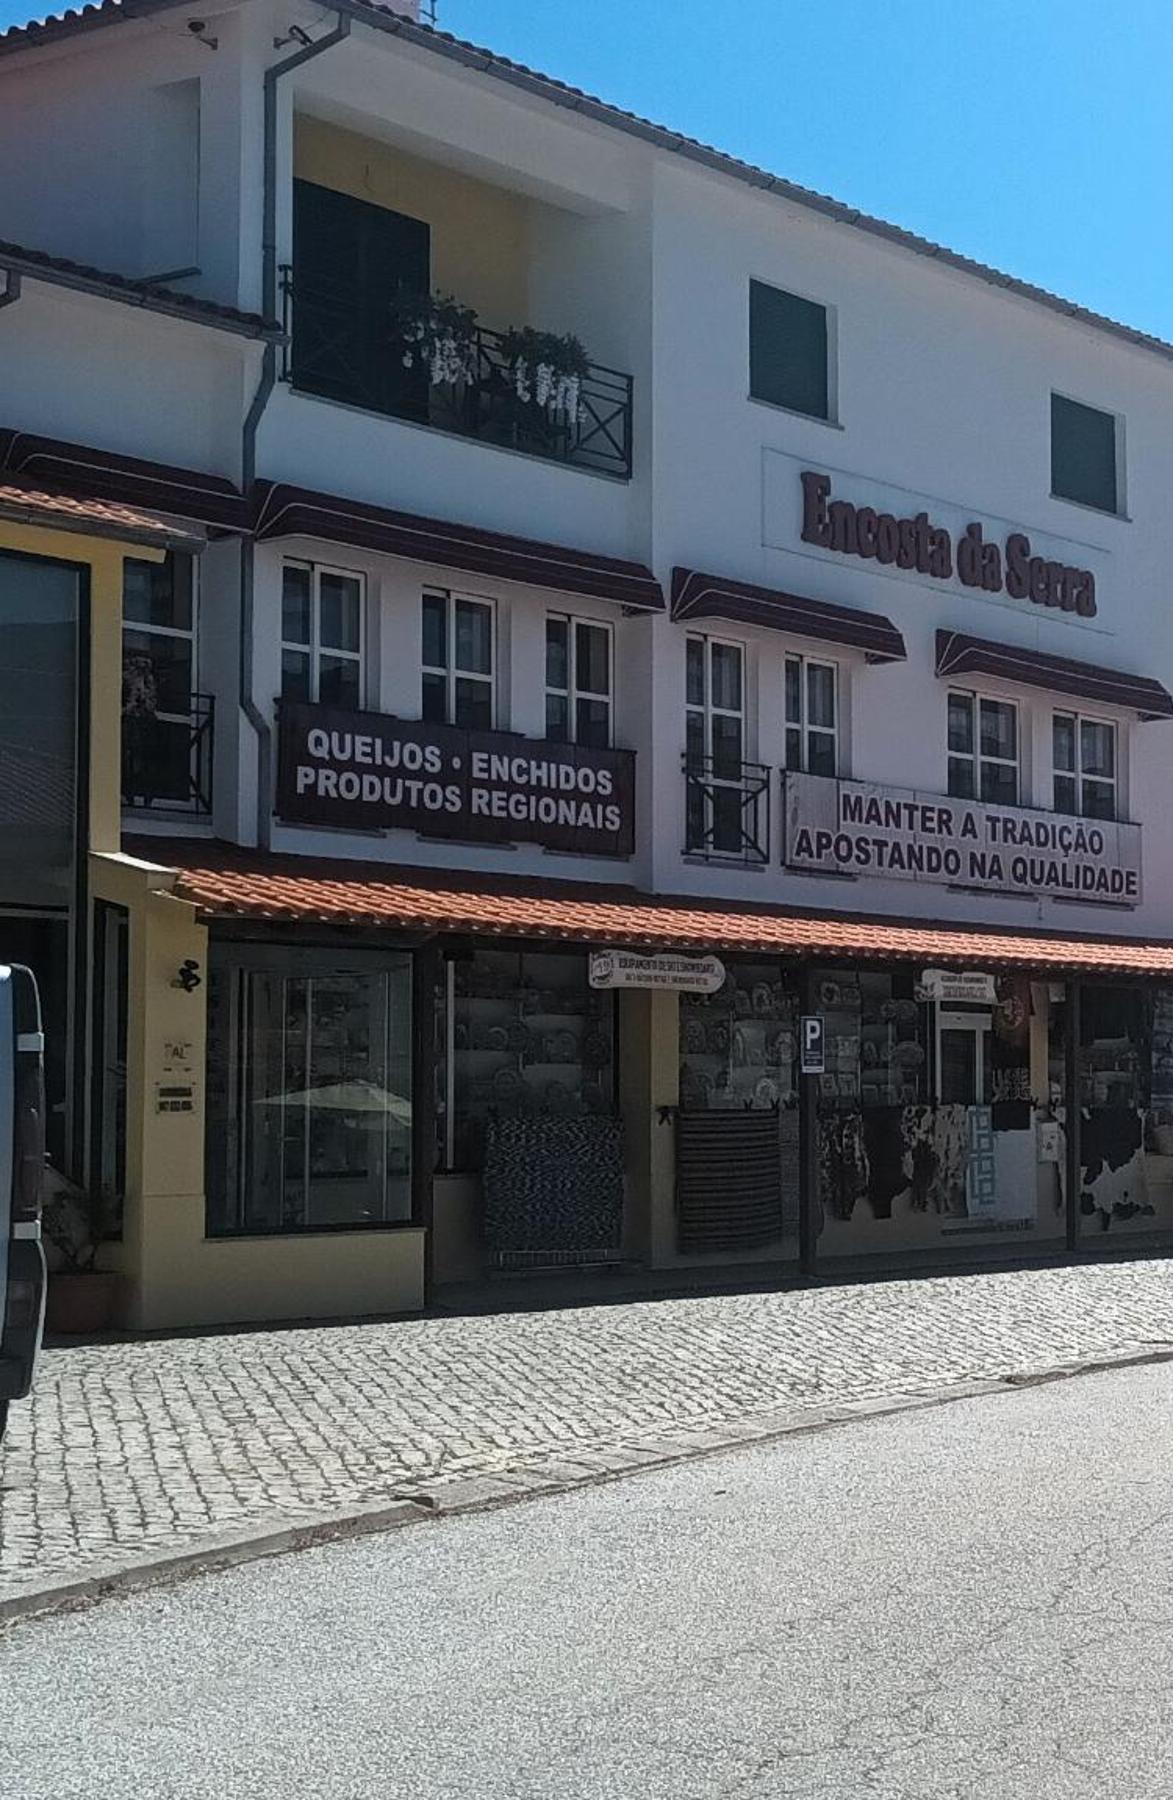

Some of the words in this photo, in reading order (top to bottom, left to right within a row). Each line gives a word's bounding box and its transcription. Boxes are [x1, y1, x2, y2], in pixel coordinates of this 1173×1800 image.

[800, 471, 952, 580] Encosta
[957, 522, 1002, 592] da
[1005, 533, 1098, 618] Serra
[307, 728, 442, 773] QUEIJOS
[471, 751, 613, 796] ENCHIDOS
[296, 765, 462, 813] PRODUTOS
[471, 787, 622, 832] REGIONAIS
[841, 793, 953, 837] MANTER
[960, 811, 978, 839] A
[986, 814, 1104, 858] TRADIÇÃO
[794, 828, 961, 876] APOSTANDO
[969, 851, 1004, 881] NA
[1011, 856, 1138, 896] QUALIDADE
[806, 1020, 820, 1049] P
